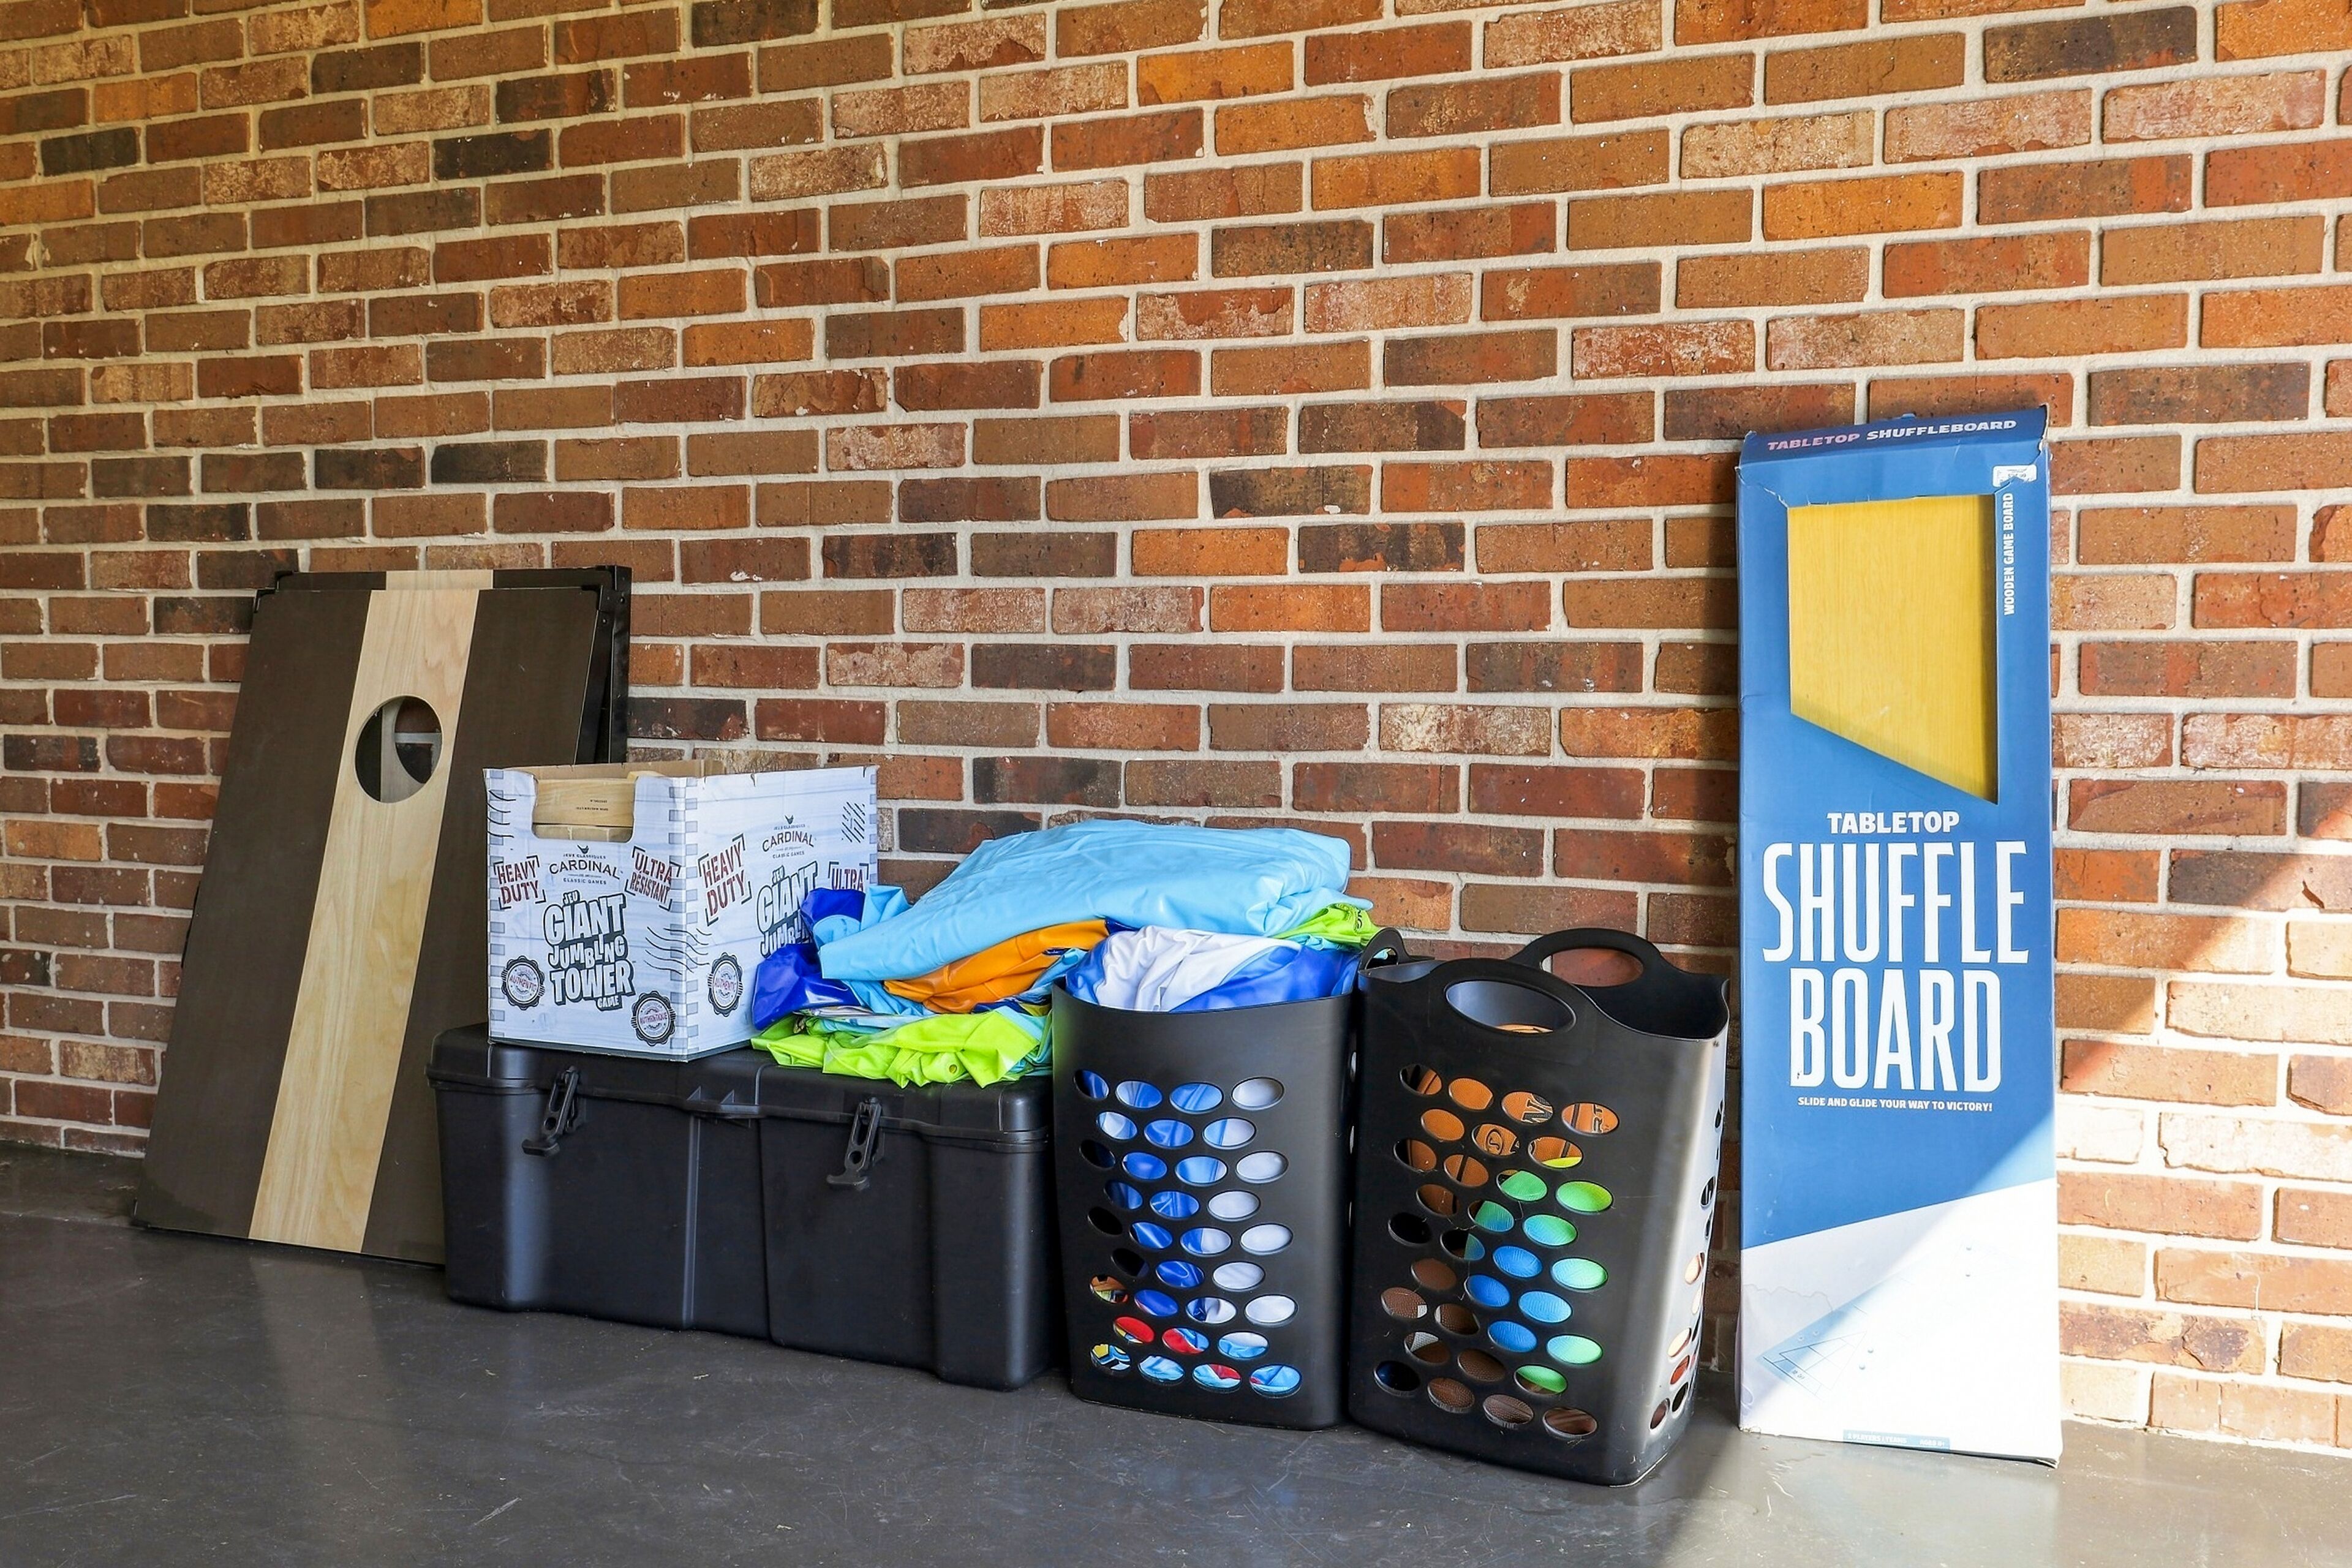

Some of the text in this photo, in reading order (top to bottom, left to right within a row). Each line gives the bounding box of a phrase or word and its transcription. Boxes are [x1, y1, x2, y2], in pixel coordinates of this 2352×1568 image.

[1768, 420, 2017, 451] TABLETOP SHUFFLEBOARD
[2002, 492, 2015, 616] WOODEN GAME BOARD
[1826, 810, 1959, 834] TABLETOP
[762, 831, 814, 852] CARDINAL
[497, 860, 536, 884] HEAVY
[549, 859, 620, 880] CARDINAL
[635, 853, 673, 886] ULTRA
[703, 841, 741, 888] HEAVY
[832, 868, 864, 892] ULTRA
[500, 880, 538, 905] DUTY
[563, 890, 580, 905] JEU
[630, 870, 671, 904] RÉSISTANT
[707, 870, 744, 916] DUTY
[756, 861, 818, 934] GIANT
[1762, 840, 2029, 963] SHUFFLE
[543, 893, 626, 947] GIANT
[548, 933, 628, 969] JUMBLING
[550, 959, 635, 1006] TOWER
[597, 995, 621, 1010] GAME
[1790, 968, 2002, 1091] BOARD
[1798, 1096, 1992, 1112] SLIDE AND GLIDE YOUR WAY TO VICTORY!
